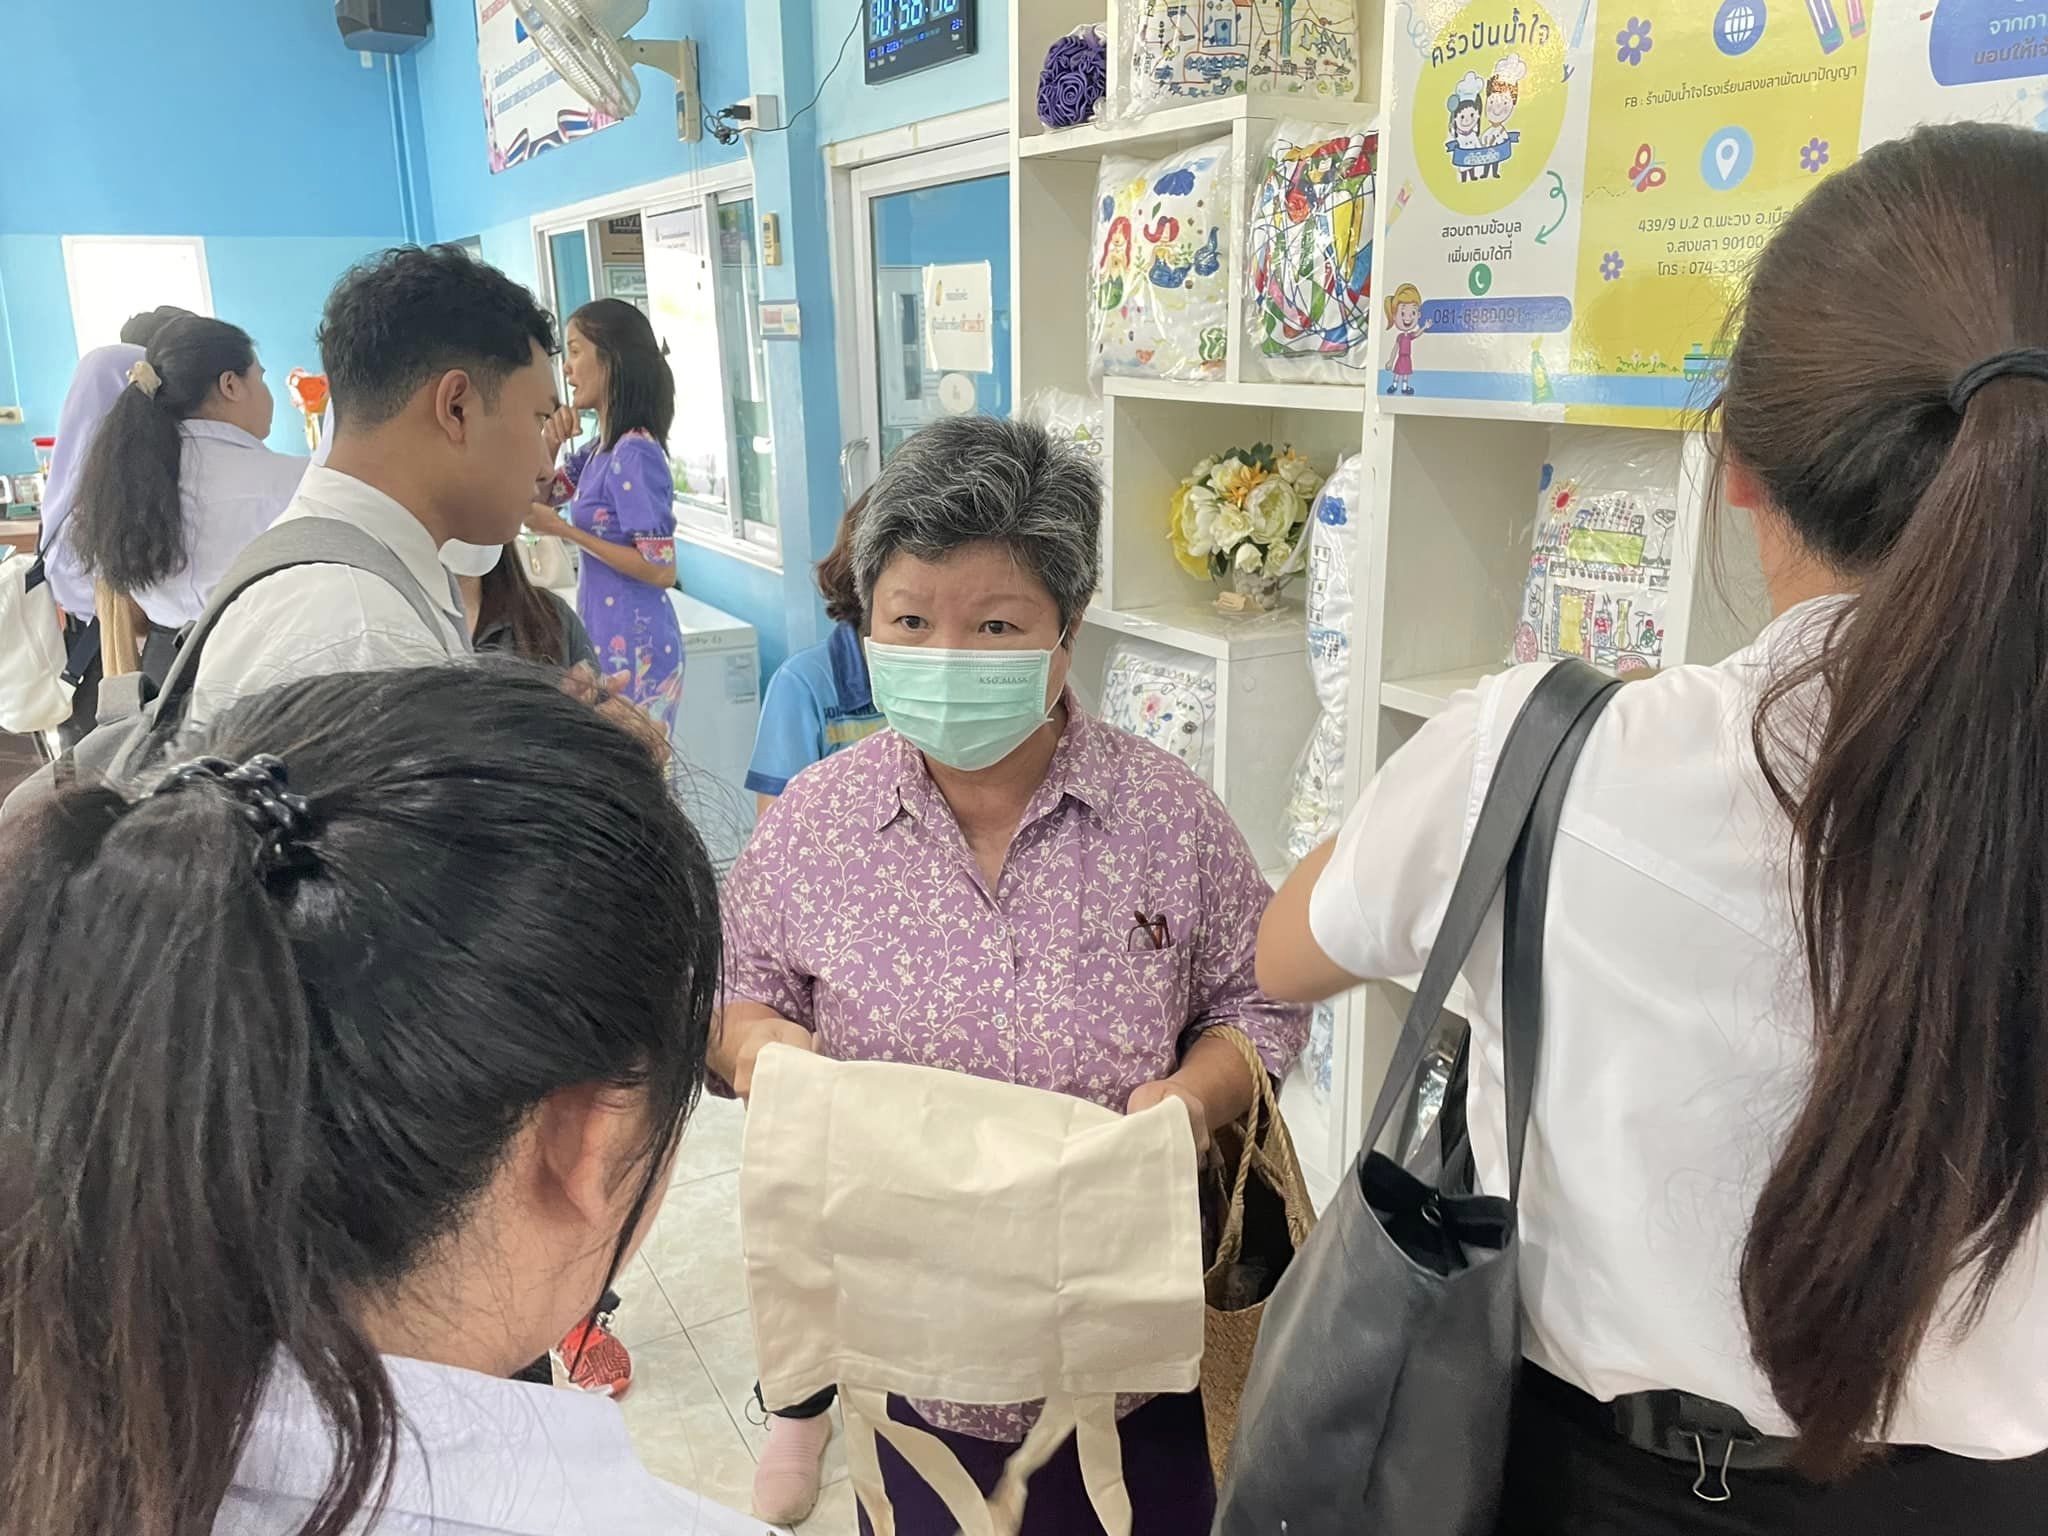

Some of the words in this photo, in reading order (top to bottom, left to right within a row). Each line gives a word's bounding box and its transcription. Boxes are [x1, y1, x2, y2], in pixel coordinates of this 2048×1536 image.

[1989, 12, 2048, 35] จากกา
[1624, 97, 1638, 108] FB
[1441, 219, 1522, 239] สอบถามข้อมูล
[1638, 217, 1676, 232] 439/9
[1679, 216, 1699, 230] ม.2
[1703, 213, 1750, 229] ต.พะวง
[1448, 240, 1513, 263] เพิ่มเติมได้ที่
[1666, 239, 1718, 254] จ.สงขลา
[1722, 234, 1764, 250] 90100
[1658, 261, 1678, 276] โทร
